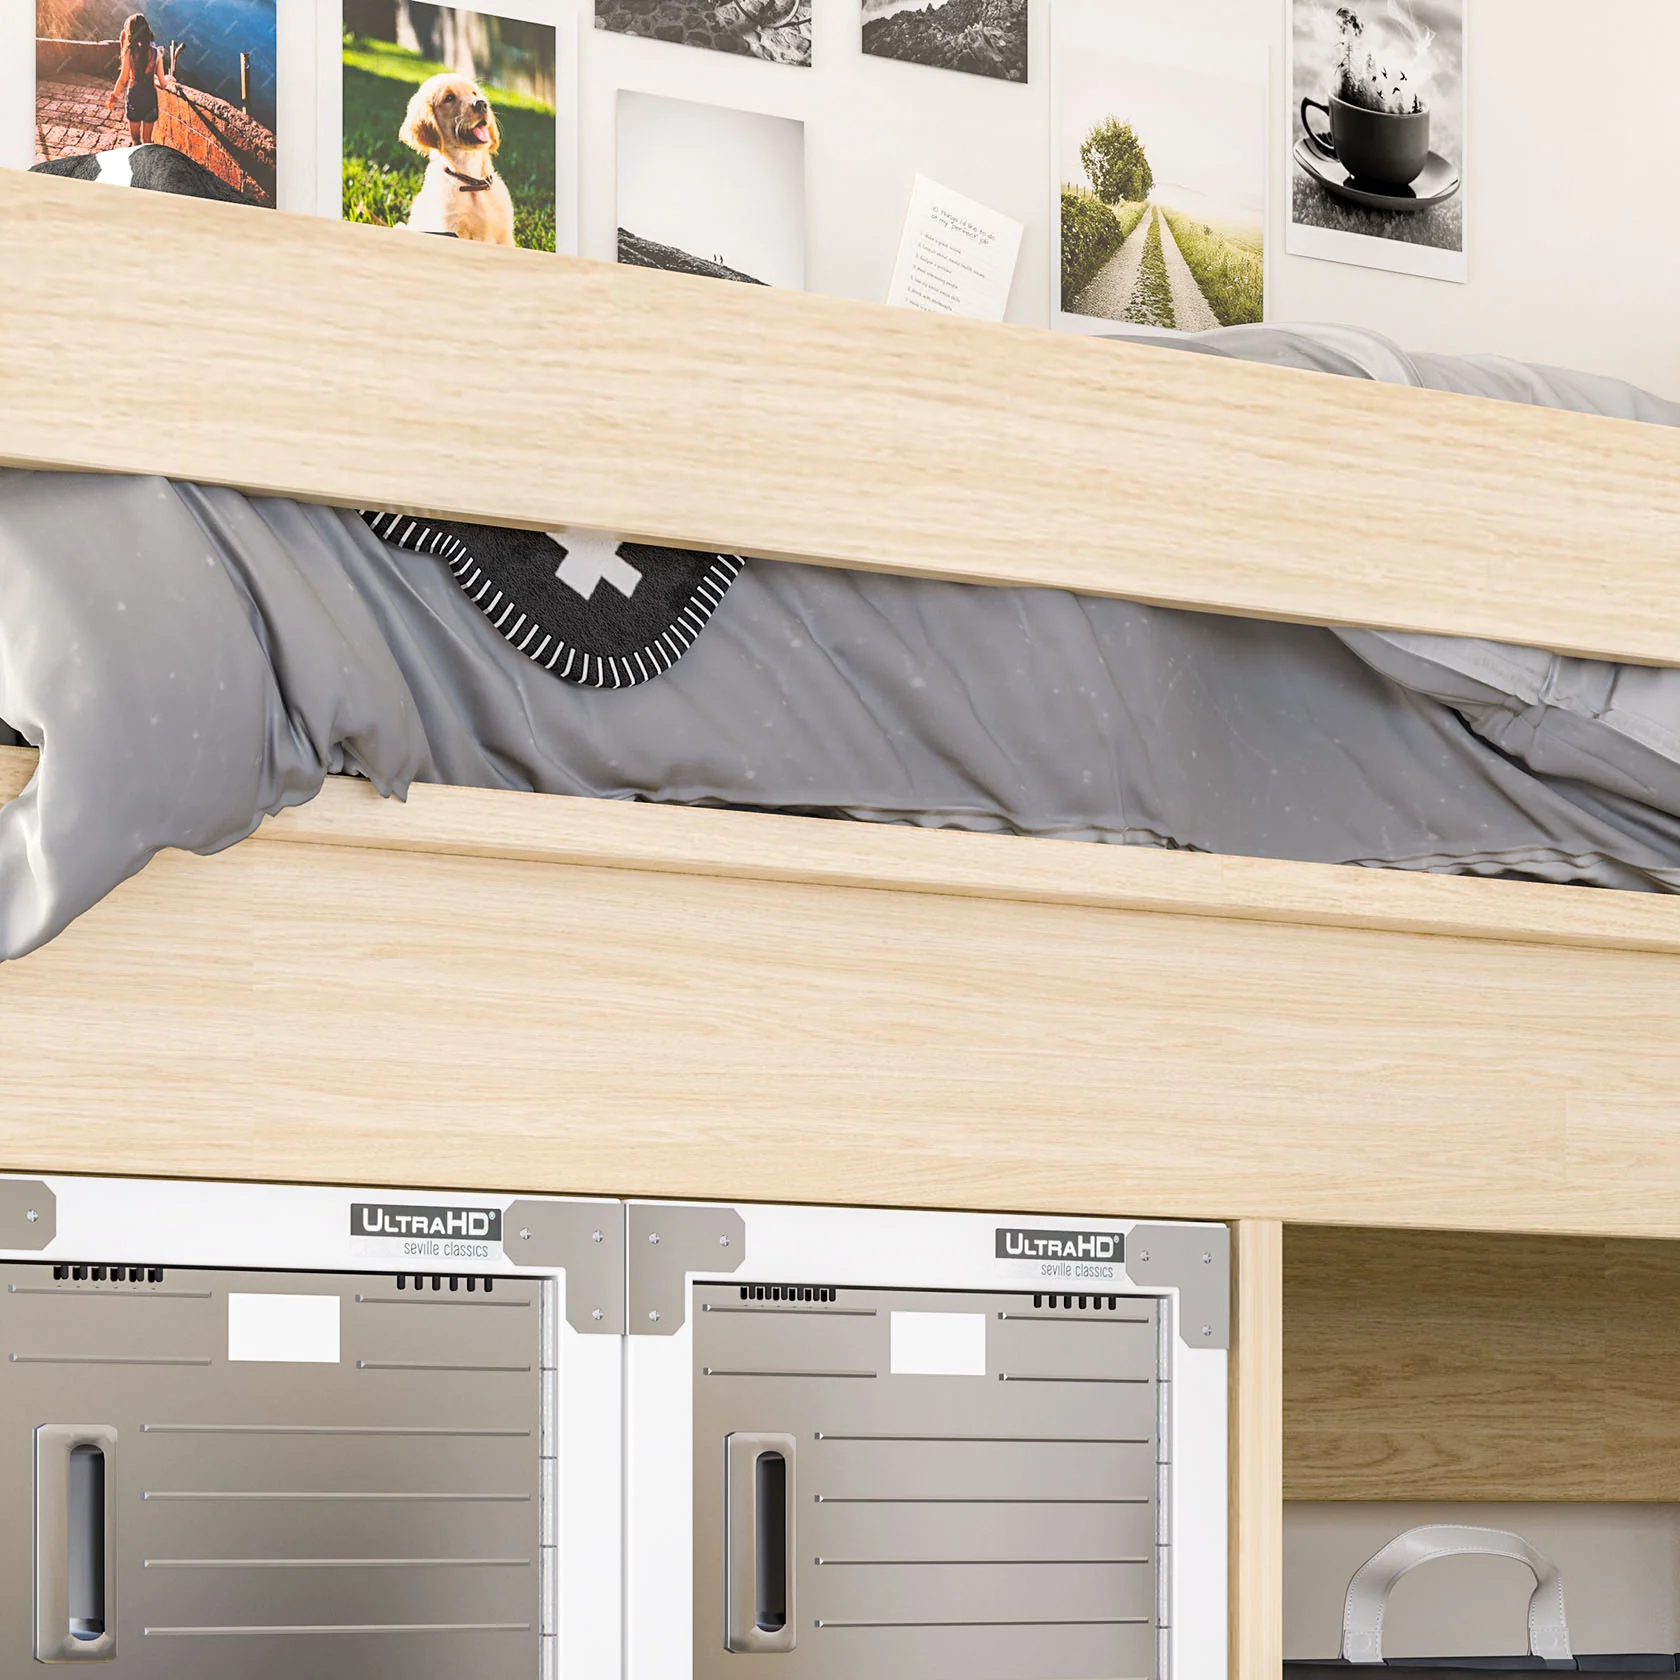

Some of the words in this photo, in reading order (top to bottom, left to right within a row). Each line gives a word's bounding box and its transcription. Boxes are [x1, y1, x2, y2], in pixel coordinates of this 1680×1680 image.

[404, 1241, 440, 1256] seville
[443, 1242, 489, 1258] classics
[1041, 1263, 1072, 1277] seville
[1075, 1265, 1114, 1278] classics
